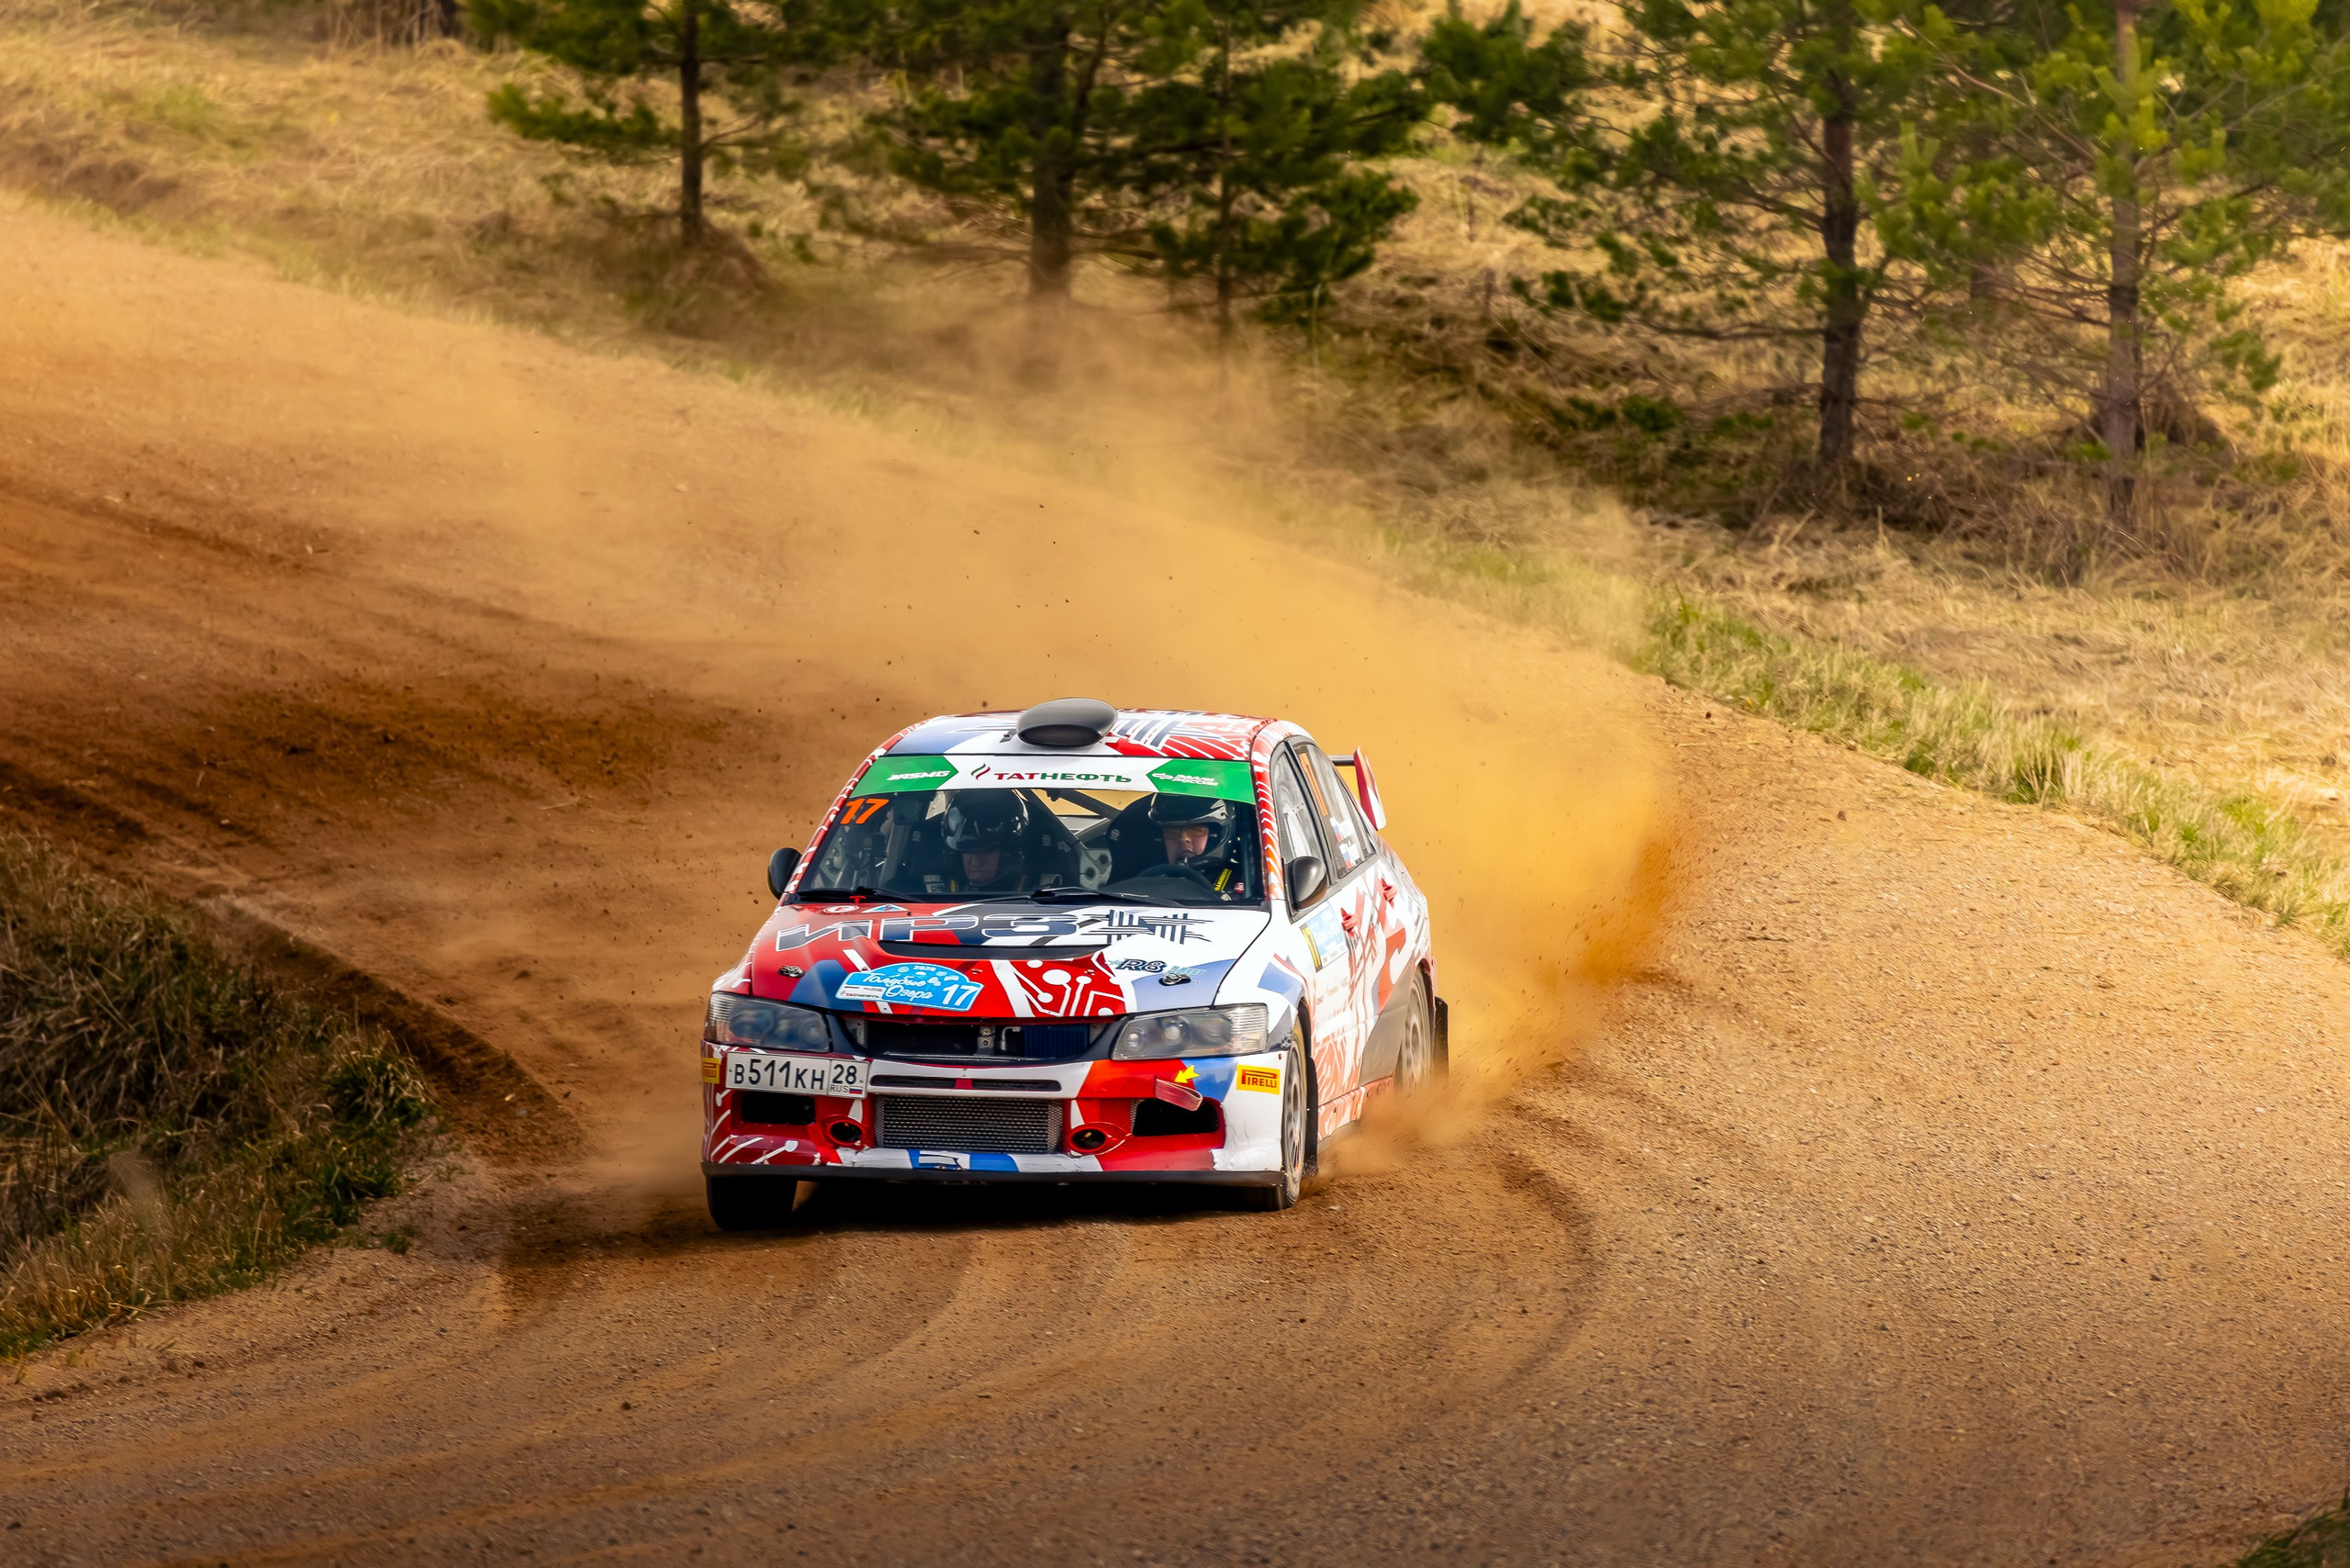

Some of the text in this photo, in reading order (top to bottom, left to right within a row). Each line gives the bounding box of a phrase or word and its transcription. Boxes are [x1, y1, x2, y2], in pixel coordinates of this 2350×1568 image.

[994, 772, 1132, 783] ТАТНЕФТЬ
[840, 798, 890, 824] 17
[1115, 958, 1168, 973] R8
[942, 983, 979, 1006] 17
[832, 1064, 857, 1085] 28
[1241, 1070, 1277, 1089] PIRELLI
[830, 1084, 849, 1093] RUS
